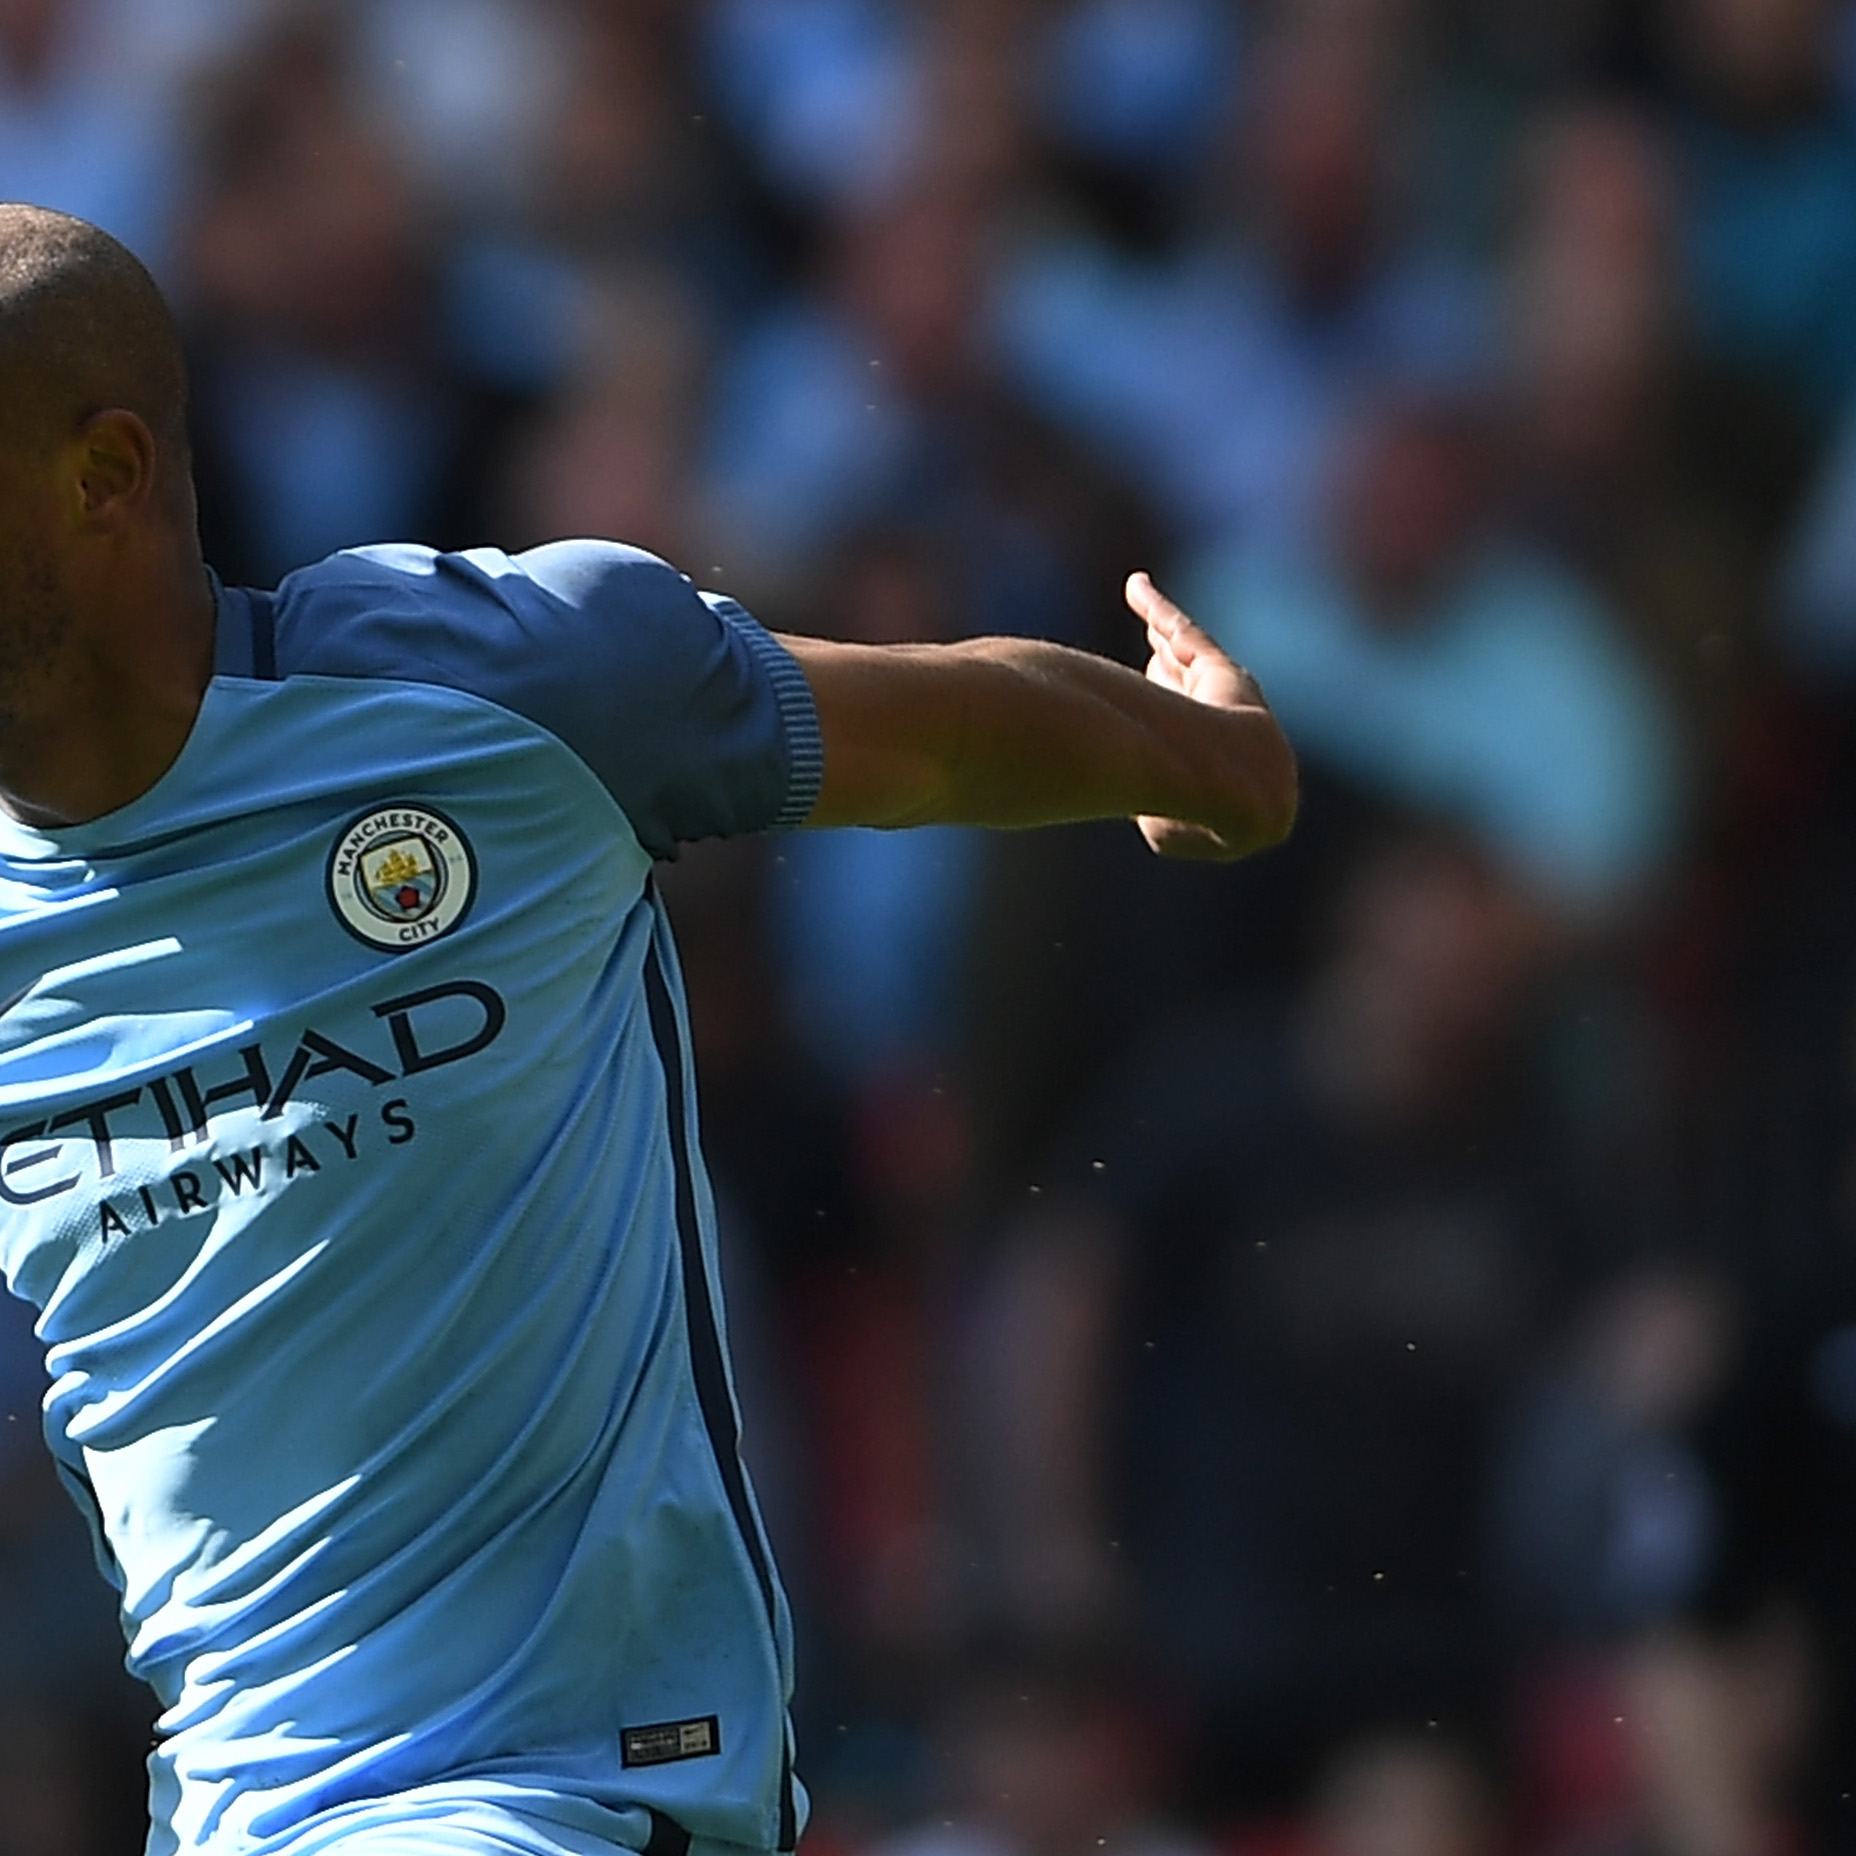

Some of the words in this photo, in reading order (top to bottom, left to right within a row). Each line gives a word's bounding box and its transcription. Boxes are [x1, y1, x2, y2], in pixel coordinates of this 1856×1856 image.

[338, 814, 449, 876] MANCHESTER
[399, 917, 439, 942] CITY
[99, 1098, 416, 1243] AIRWAYS
